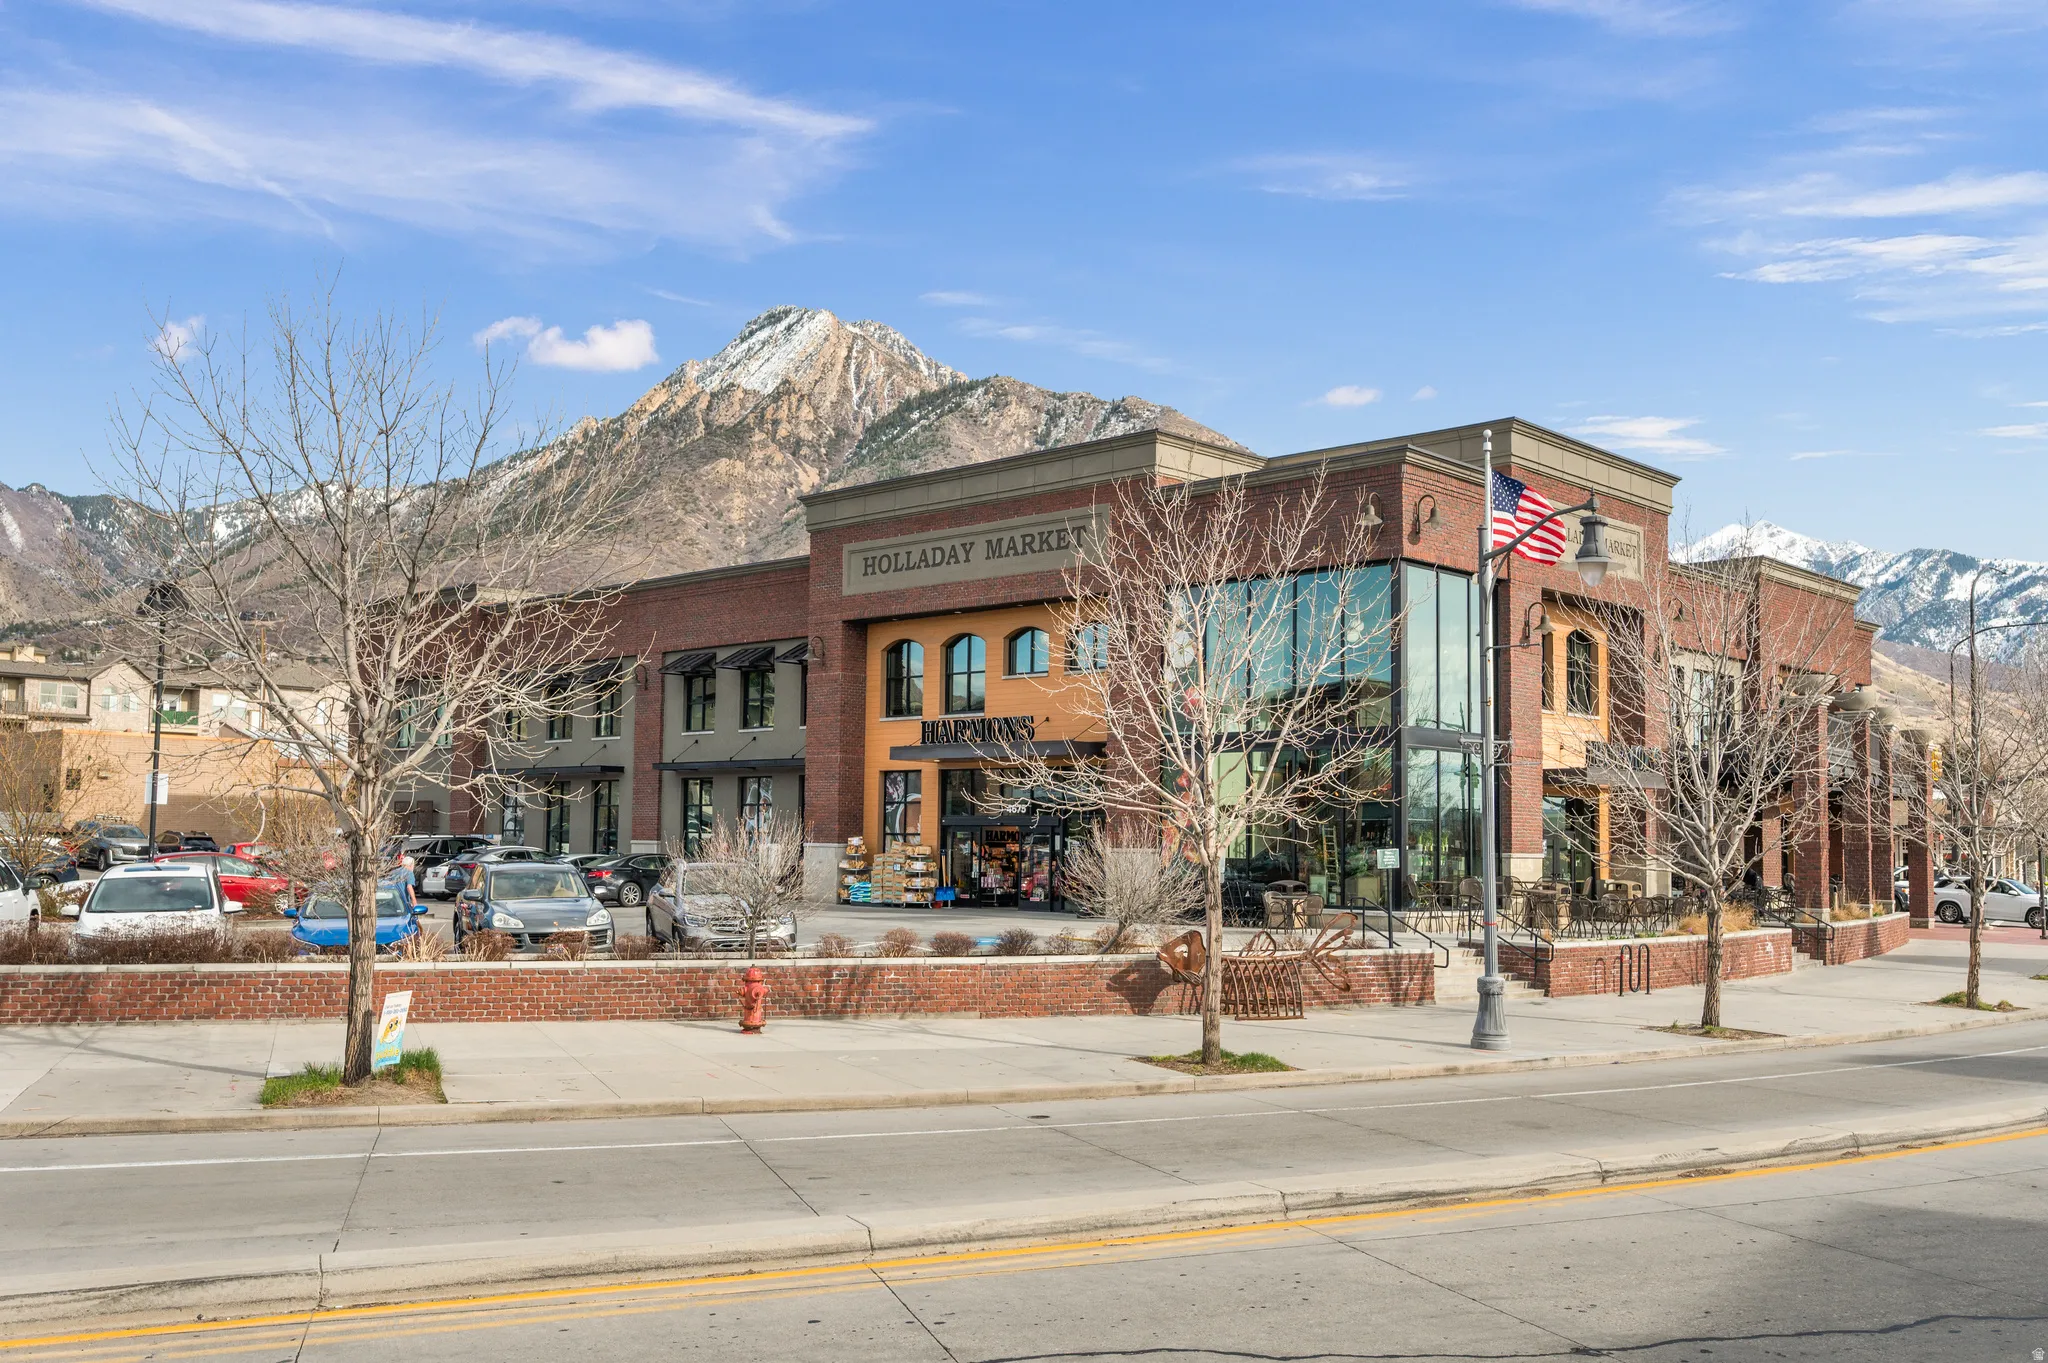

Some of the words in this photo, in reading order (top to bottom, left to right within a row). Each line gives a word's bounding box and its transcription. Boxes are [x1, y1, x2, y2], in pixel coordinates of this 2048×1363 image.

[862, 541, 975, 577] HOLLADAY
[984, 525, 1088, 560] MARKET
[920, 716, 1035, 744] HARMONS
[1007, 804, 1027, 814] 4675
